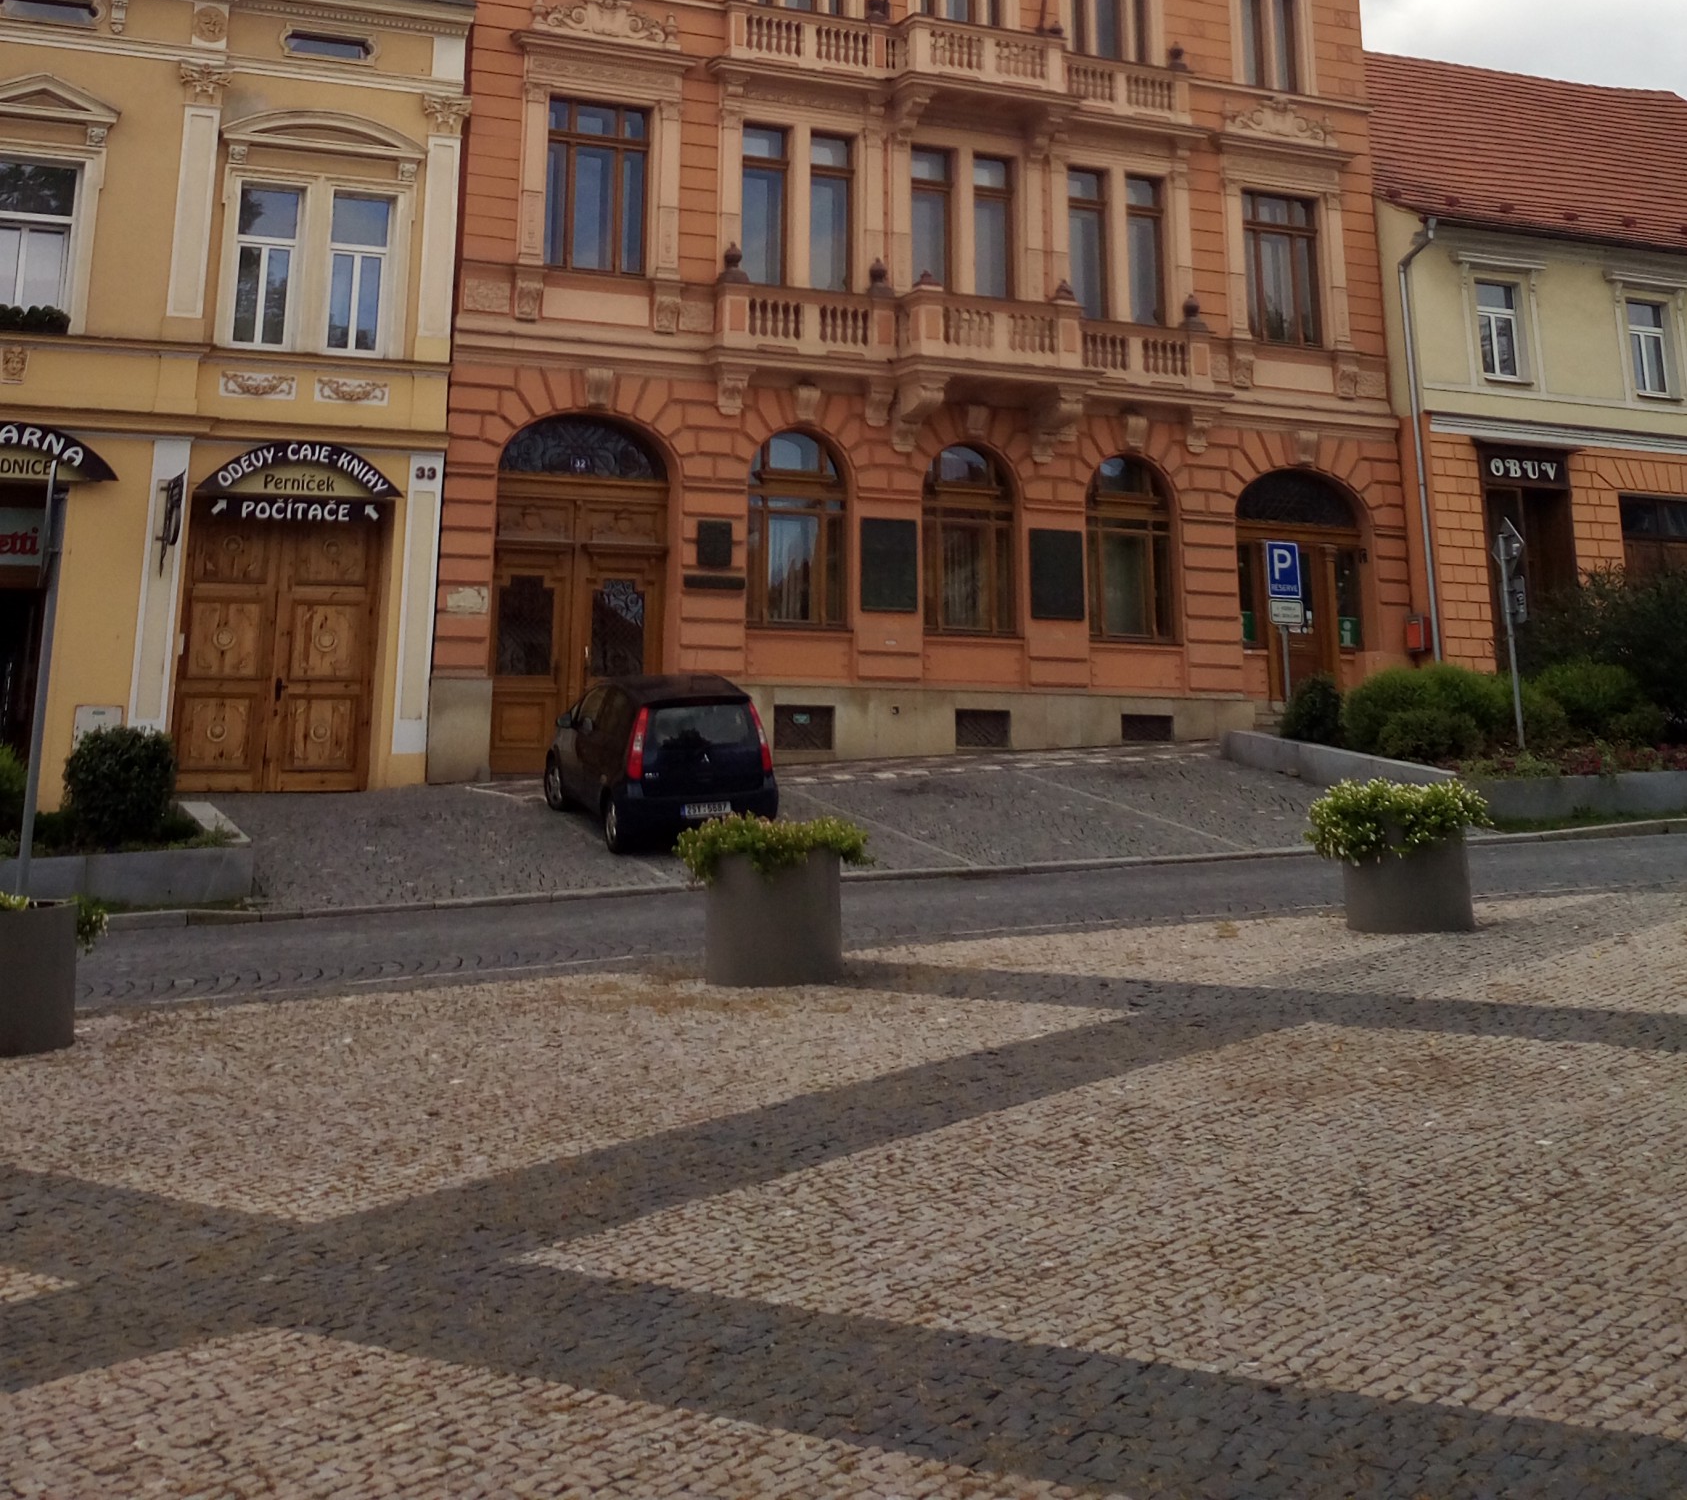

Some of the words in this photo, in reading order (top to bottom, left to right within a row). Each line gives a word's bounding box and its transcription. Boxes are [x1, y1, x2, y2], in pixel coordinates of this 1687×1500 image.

[337, 452, 389, 494] KNIHY
[415, 466, 437, 480] 33
[1490, 458, 1557, 480] OBUV
[263, 473, 335, 492] Perníček
[241, 498, 351, 522] POČÍTAČE
[1272, 548, 1292, 580] P
